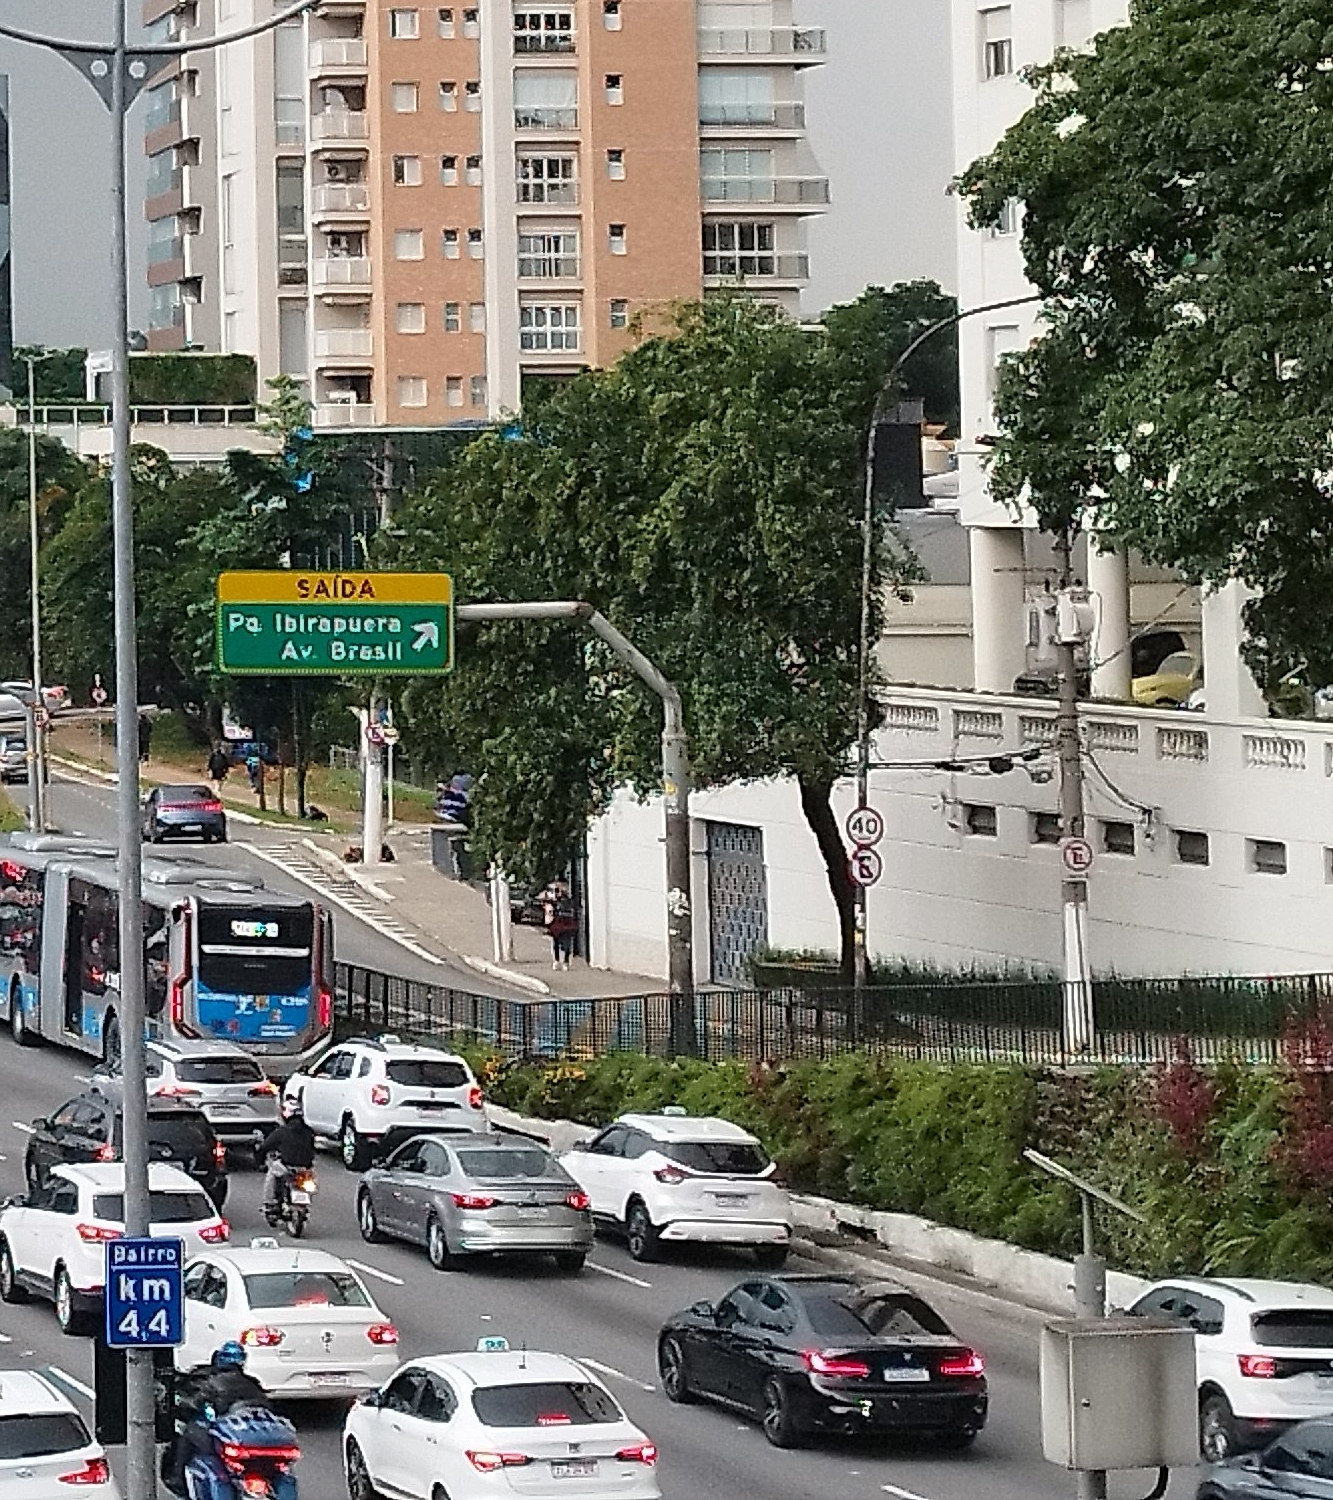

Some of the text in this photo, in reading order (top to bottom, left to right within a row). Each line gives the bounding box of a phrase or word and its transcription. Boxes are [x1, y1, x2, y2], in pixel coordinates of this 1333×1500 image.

[297, 575, 376, 598] SAÍDA
[276, 613, 401, 635] Ibirapuera
[331, 641, 401, 660] Brasil
[852, 817, 878, 835] 40
[115, 1245, 177, 1264] Bairro
[119, 1273, 171, 1302] km
